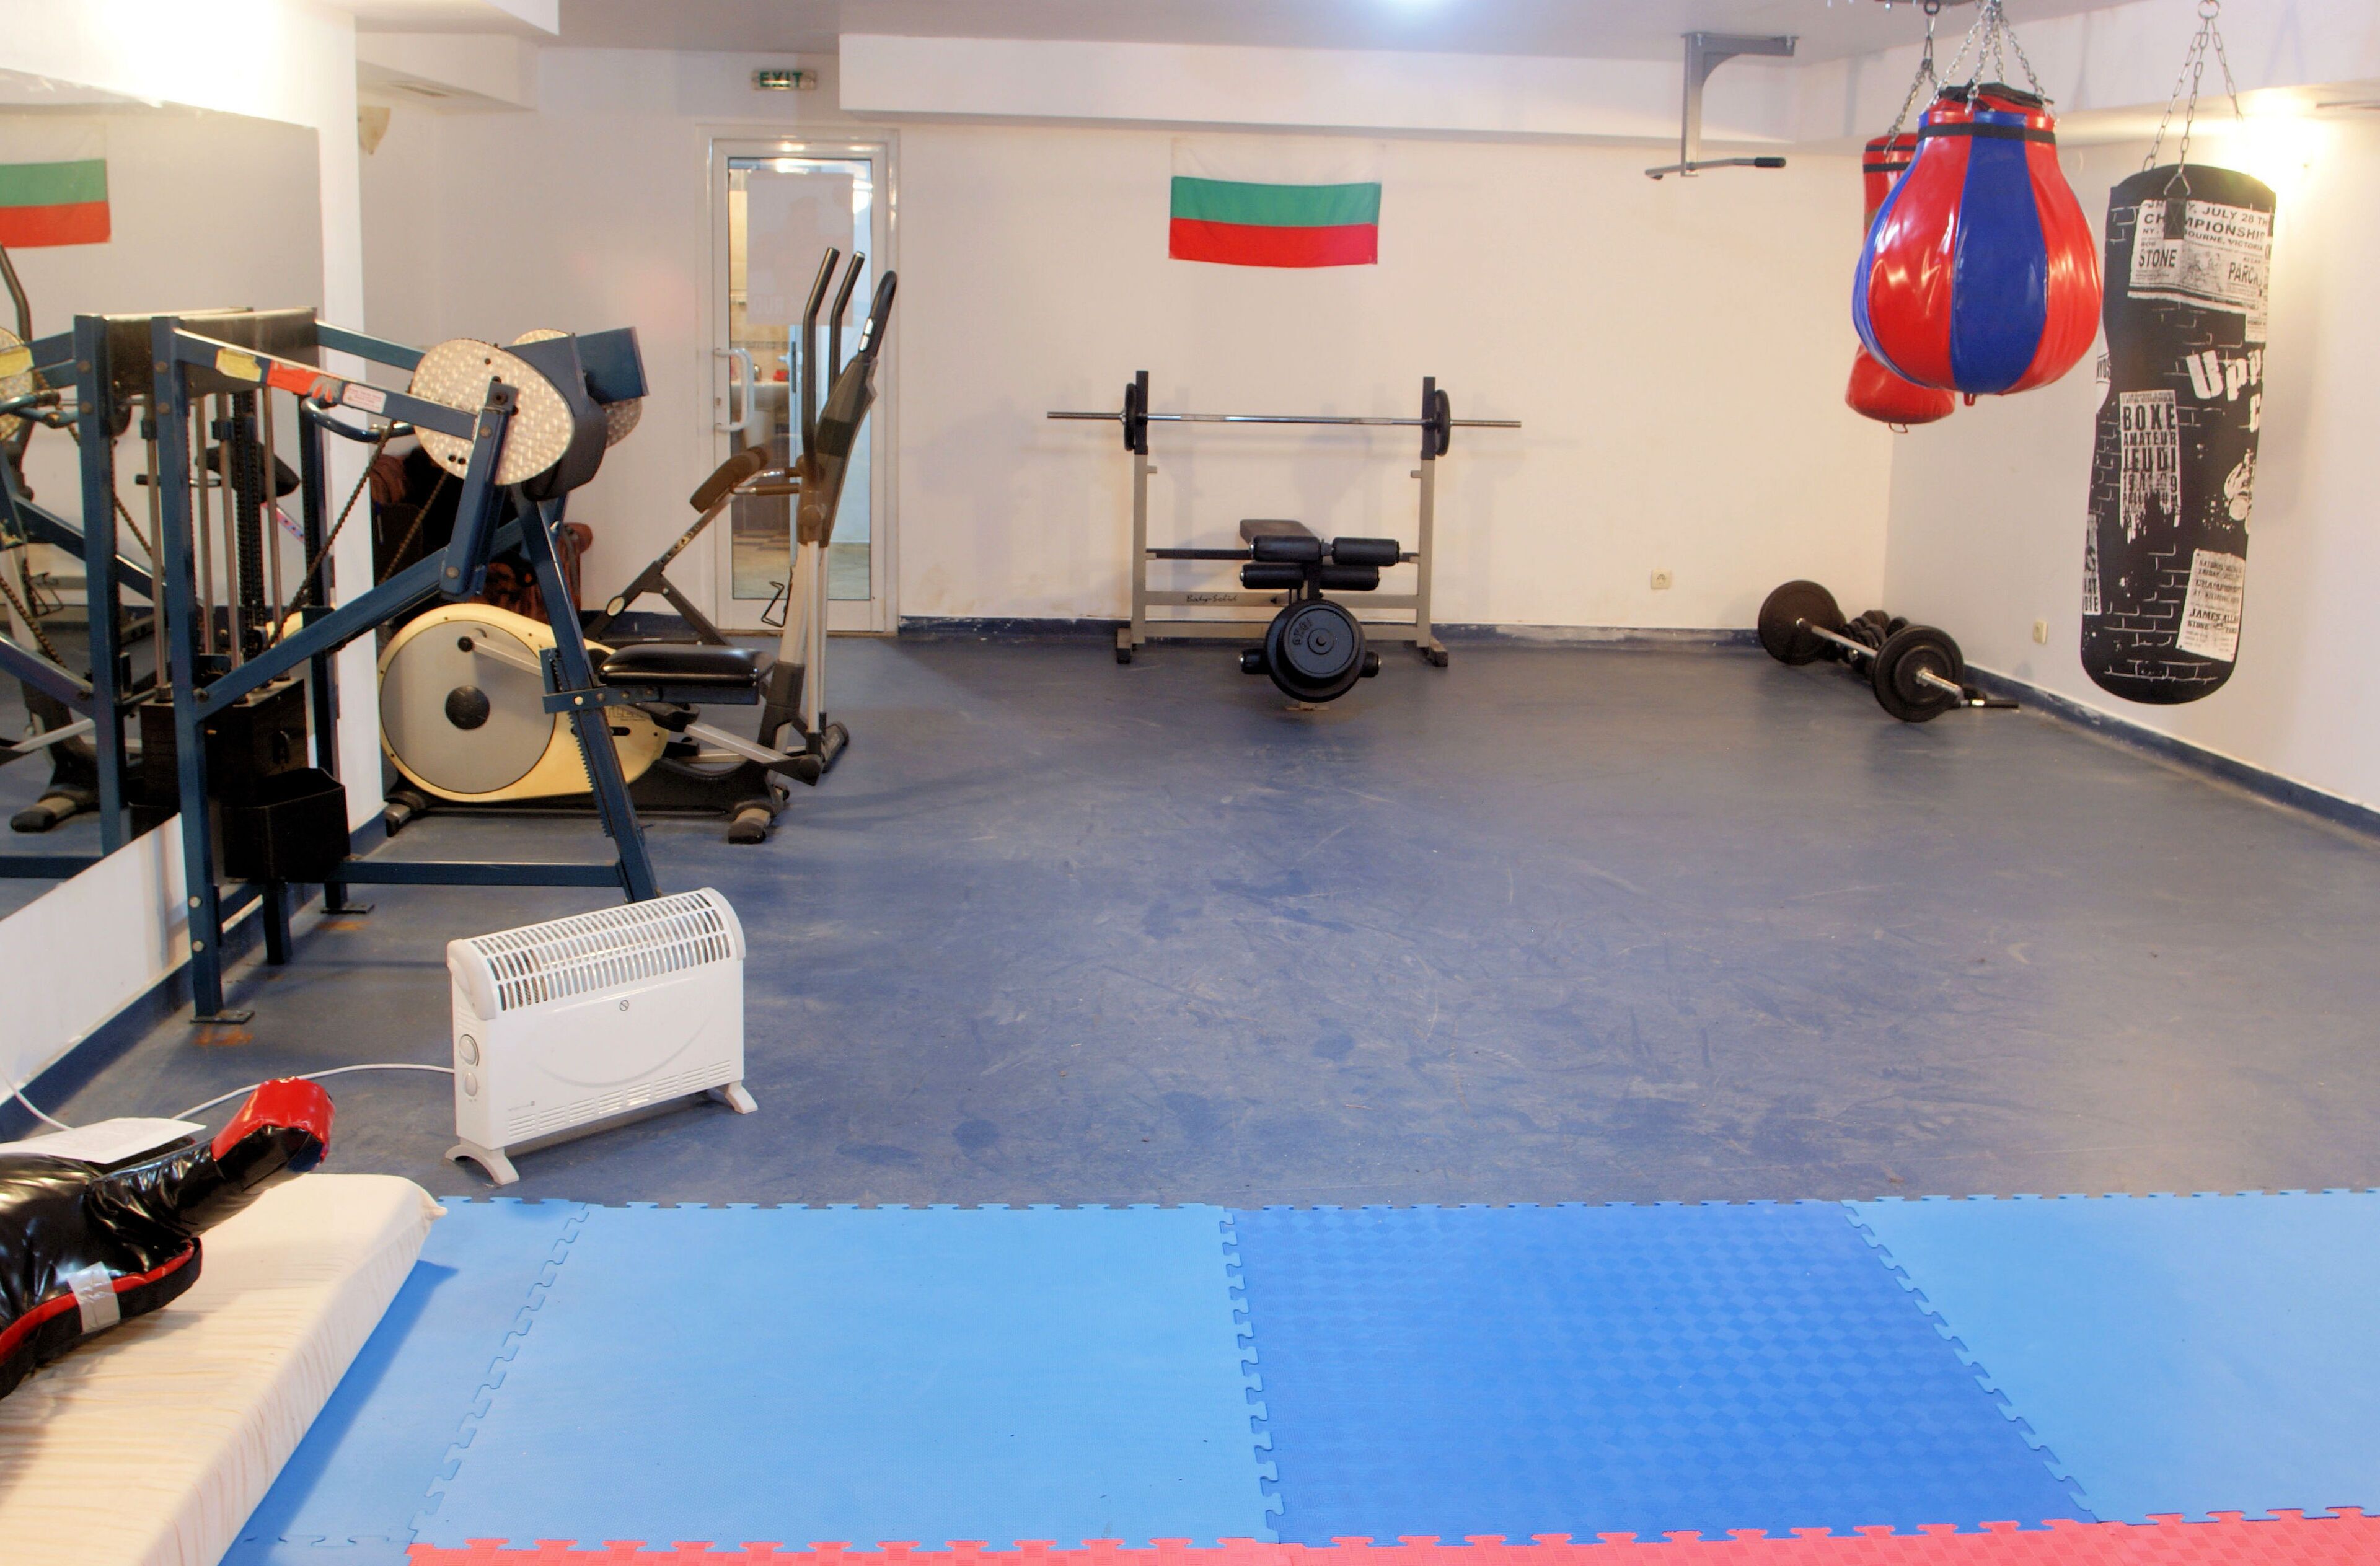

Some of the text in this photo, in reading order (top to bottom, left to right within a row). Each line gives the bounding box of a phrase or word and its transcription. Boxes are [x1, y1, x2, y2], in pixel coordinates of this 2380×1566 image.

[759, 71, 803, 88] EXIT
[2202, 206, 2237, 220] JULY
[2138, 248, 2177, 268] STONE
[2123, 403, 2176, 431] BOXE
[2123, 431, 2177, 446] AMATEUR
